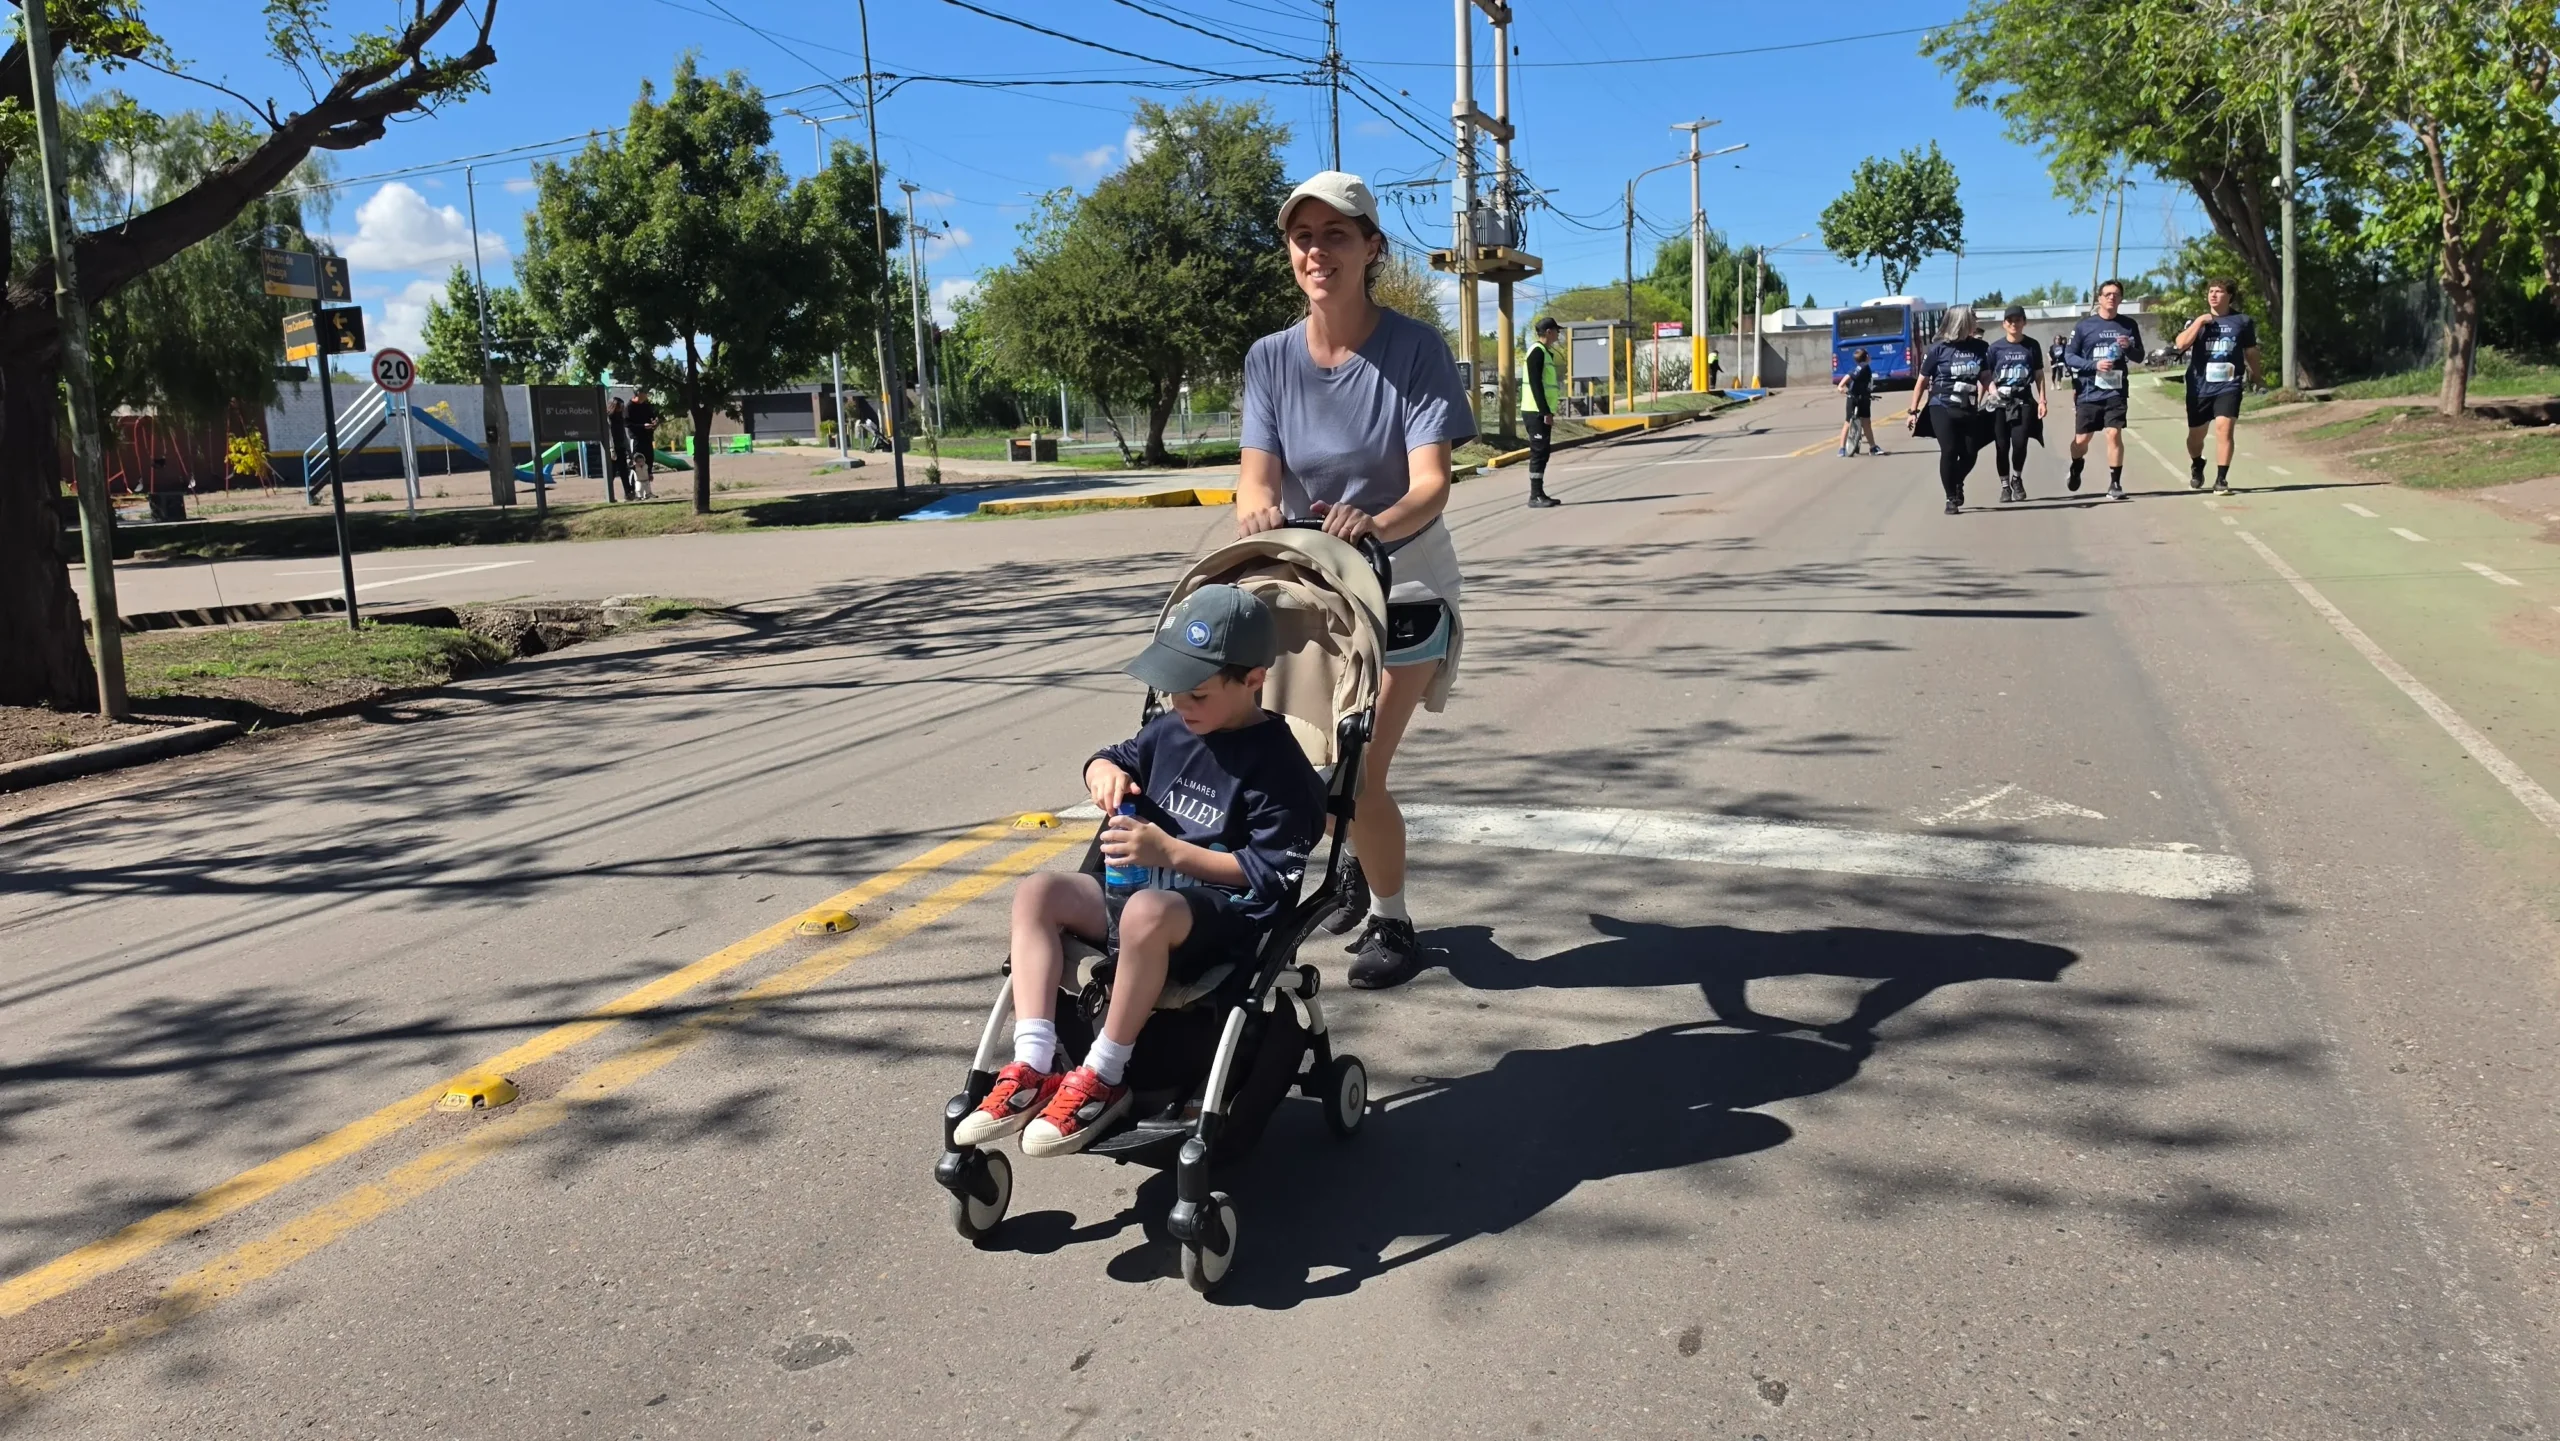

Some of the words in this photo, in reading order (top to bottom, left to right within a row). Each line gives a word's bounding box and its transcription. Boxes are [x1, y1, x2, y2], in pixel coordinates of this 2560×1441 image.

[379, 360, 409, 380] 20
[569, 406, 593, 415] Robles
[1175, 777, 1217, 799] ALMARES
[1159, 790, 1225, 829] ALLEY
